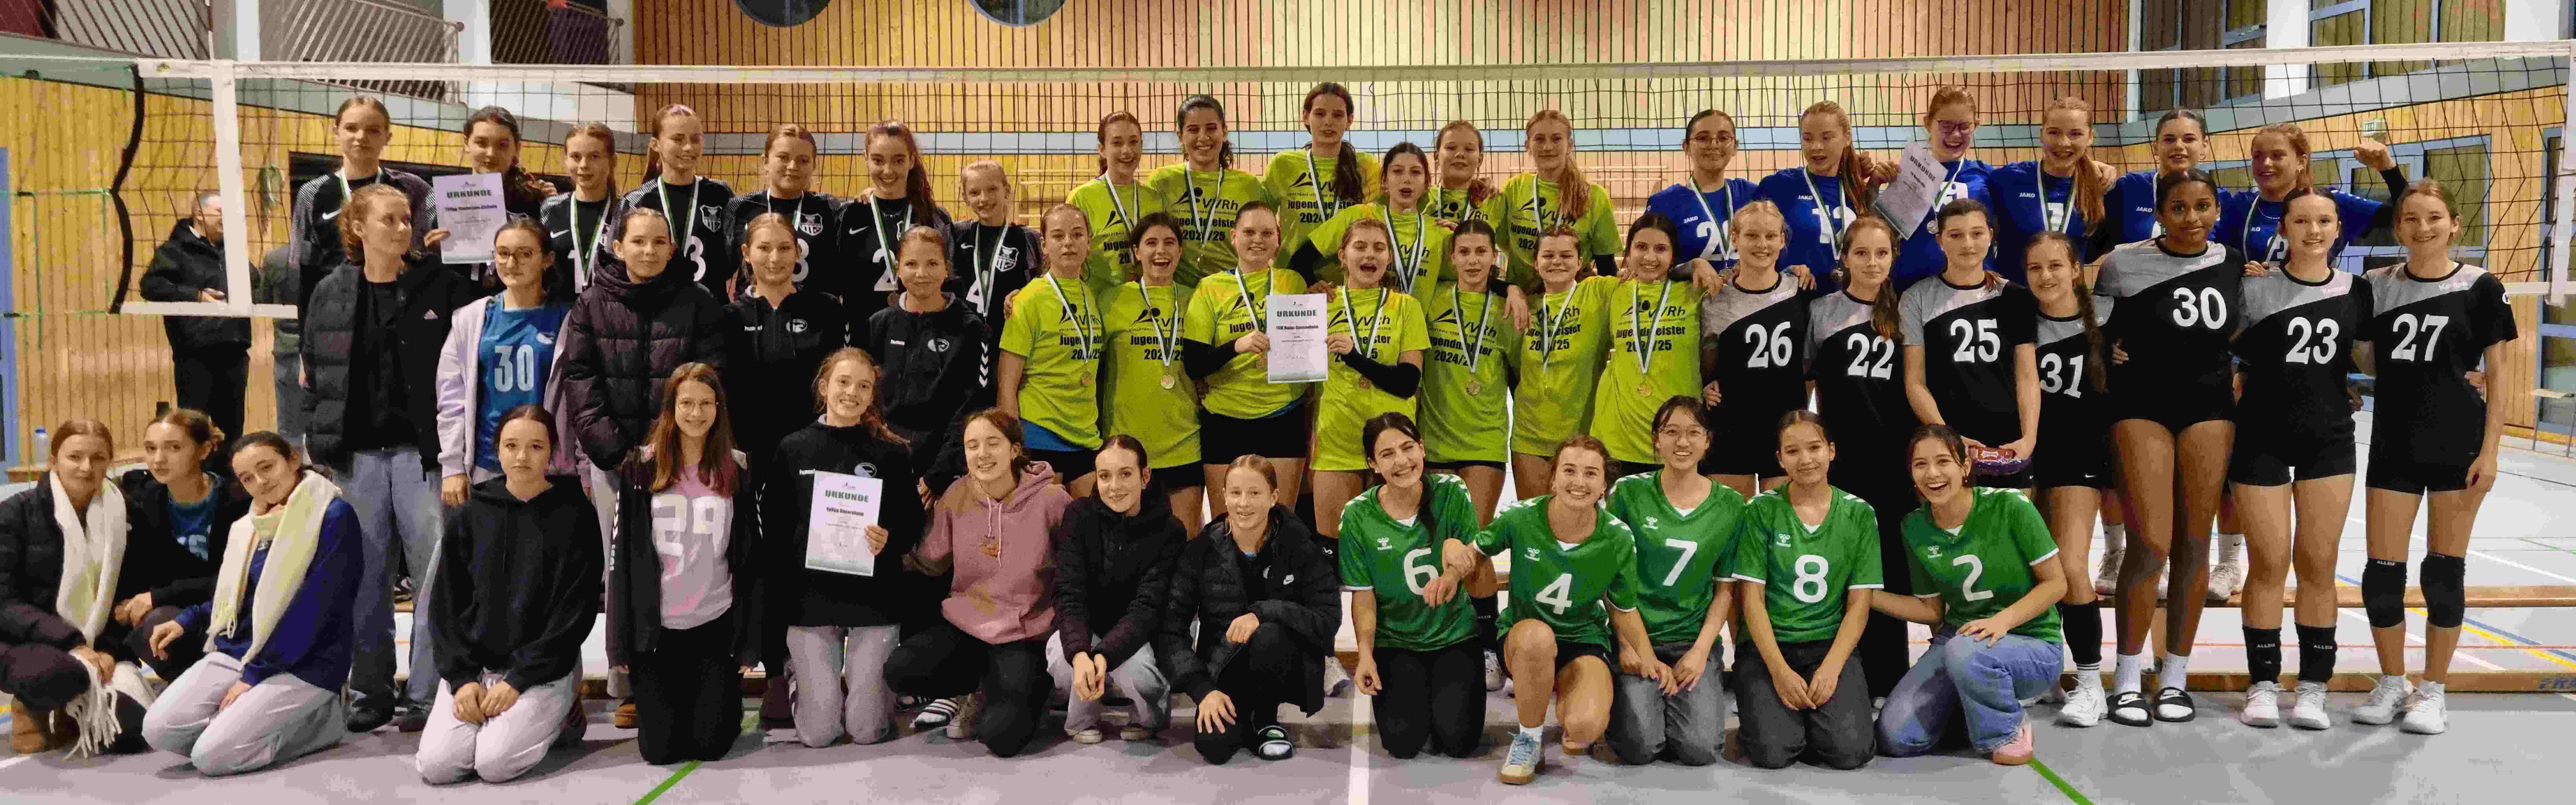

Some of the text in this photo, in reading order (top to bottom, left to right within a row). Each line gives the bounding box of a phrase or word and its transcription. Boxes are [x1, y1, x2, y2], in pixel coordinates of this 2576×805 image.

[1910, 155, 1936, 182] URKUNDE
[447, 190, 492, 198] URKUNDE
[1288, 199, 1356, 209] Jugendeste
[1183, 230, 1226, 241] 202/25
[2173, 287, 2227, 329] 30
[1529, 339, 1570, 351] 20/25
[1616, 326, 1686, 338] Jugedeister
[1626, 339, 1672, 352] 22/25
[1746, 321, 1793, 368] 26
[1950, 318, 2001, 363] 25
[2286, 317, 2339, 364] 23
[2391, 313, 2449, 361] 27
[494, 344, 534, 392] 30
[1144, 349, 1184, 361] 202/2
[1434, 350, 1468, 366] 2024/2
[1847, 333, 1895, 380] 22
[2040, 353, 2083, 398] 31
[825, 489, 869, 503] URKUNDE
[651, 494, 726, 558] 29
[1404, 547, 1439, 595] 6
[1663, 538, 1698, 586] 7
[1794, 554, 1829, 603] 8
[1953, 554, 1994, 602] 2
[1536, 573, 1572, 615] 4
